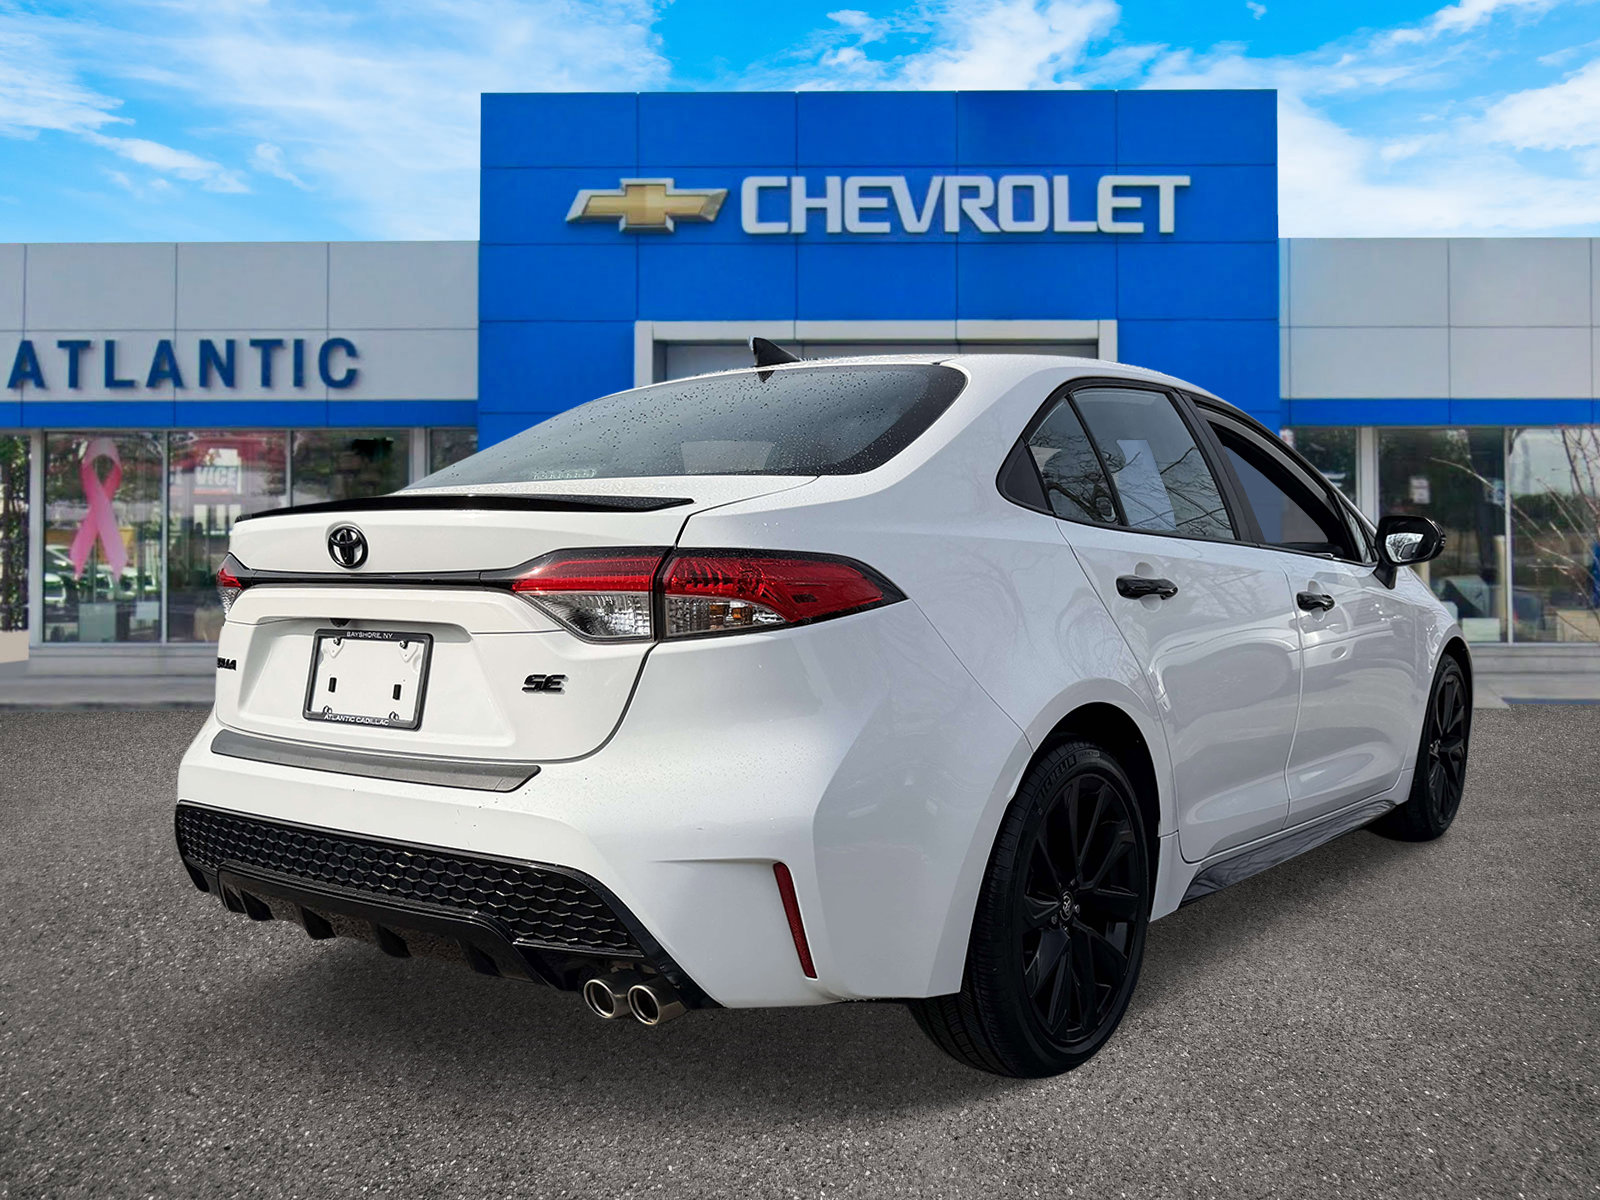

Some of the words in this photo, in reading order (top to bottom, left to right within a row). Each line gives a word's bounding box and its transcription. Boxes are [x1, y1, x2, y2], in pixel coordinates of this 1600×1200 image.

[741, 175, 1191, 233] CHEVROLET
[7, 337, 358, 389] ATLANTIC
[521, 674, 566, 693] SE
[323, 712, 355, 723] ATLANTIC
[355, 716, 389, 726] CADILLAC
